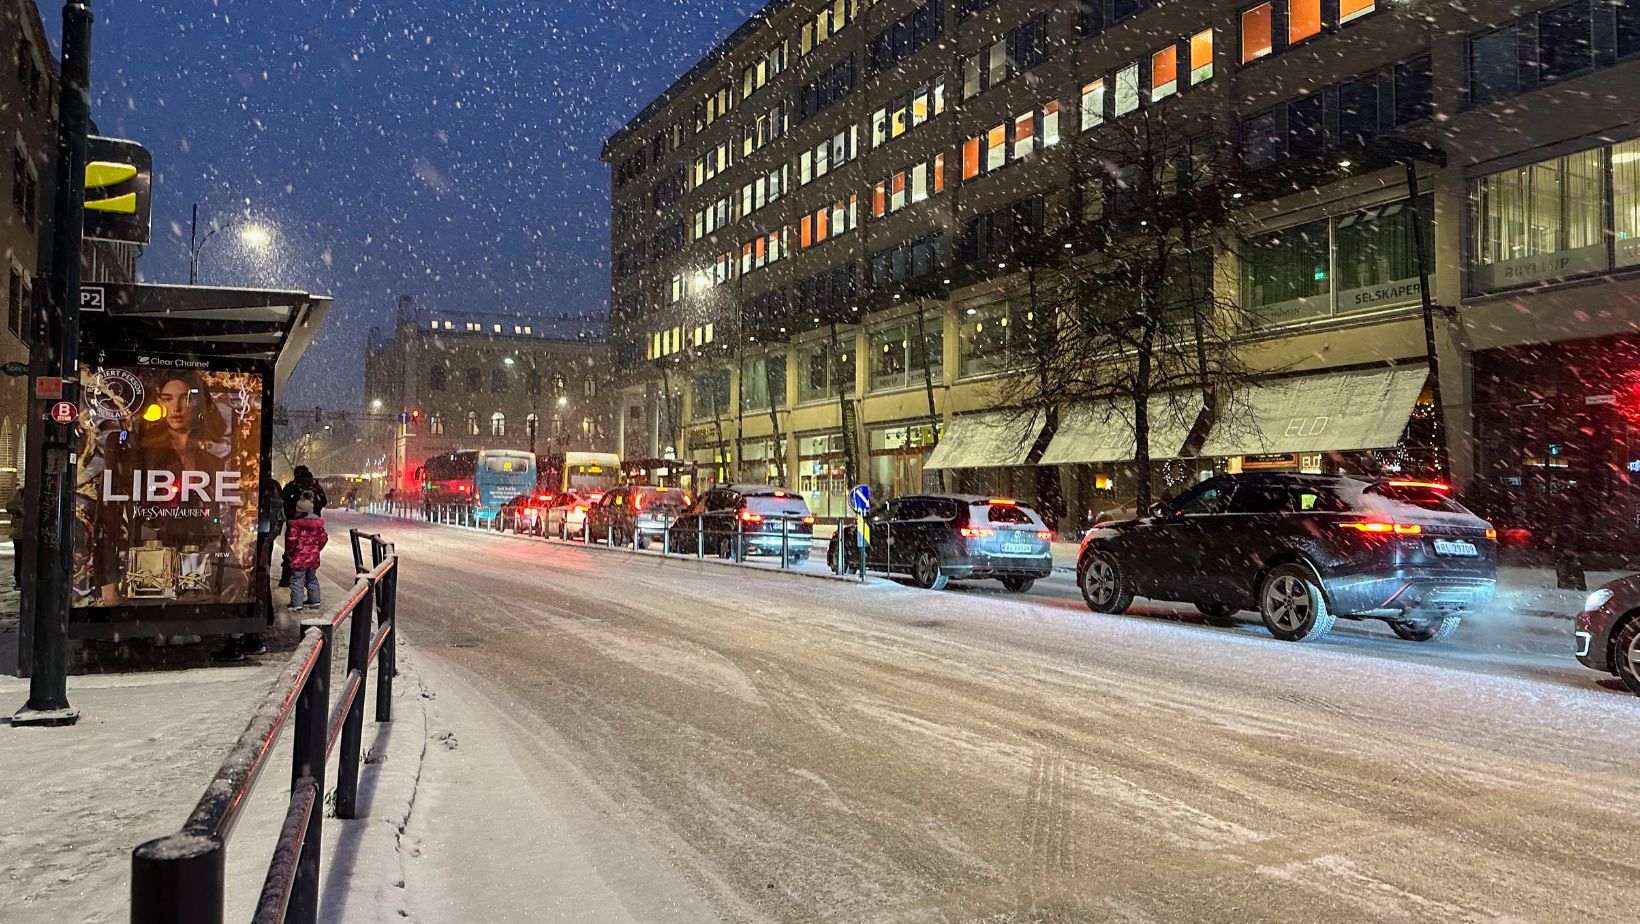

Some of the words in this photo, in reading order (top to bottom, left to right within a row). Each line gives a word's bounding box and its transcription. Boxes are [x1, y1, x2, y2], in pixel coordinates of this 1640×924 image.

[80, 292, 101, 306] P2
[1355, 283, 1421, 304] SELSKAPER
[151, 358, 173, 366] Clear
[175, 359, 209, 368] Channel
[121, 371, 142, 395] PERSON
[59, 404, 70, 416] B
[1284, 417, 1328, 436] ELD
[1302, 454, 1321, 468] ELD
[103, 469, 241, 502] LIBRE
